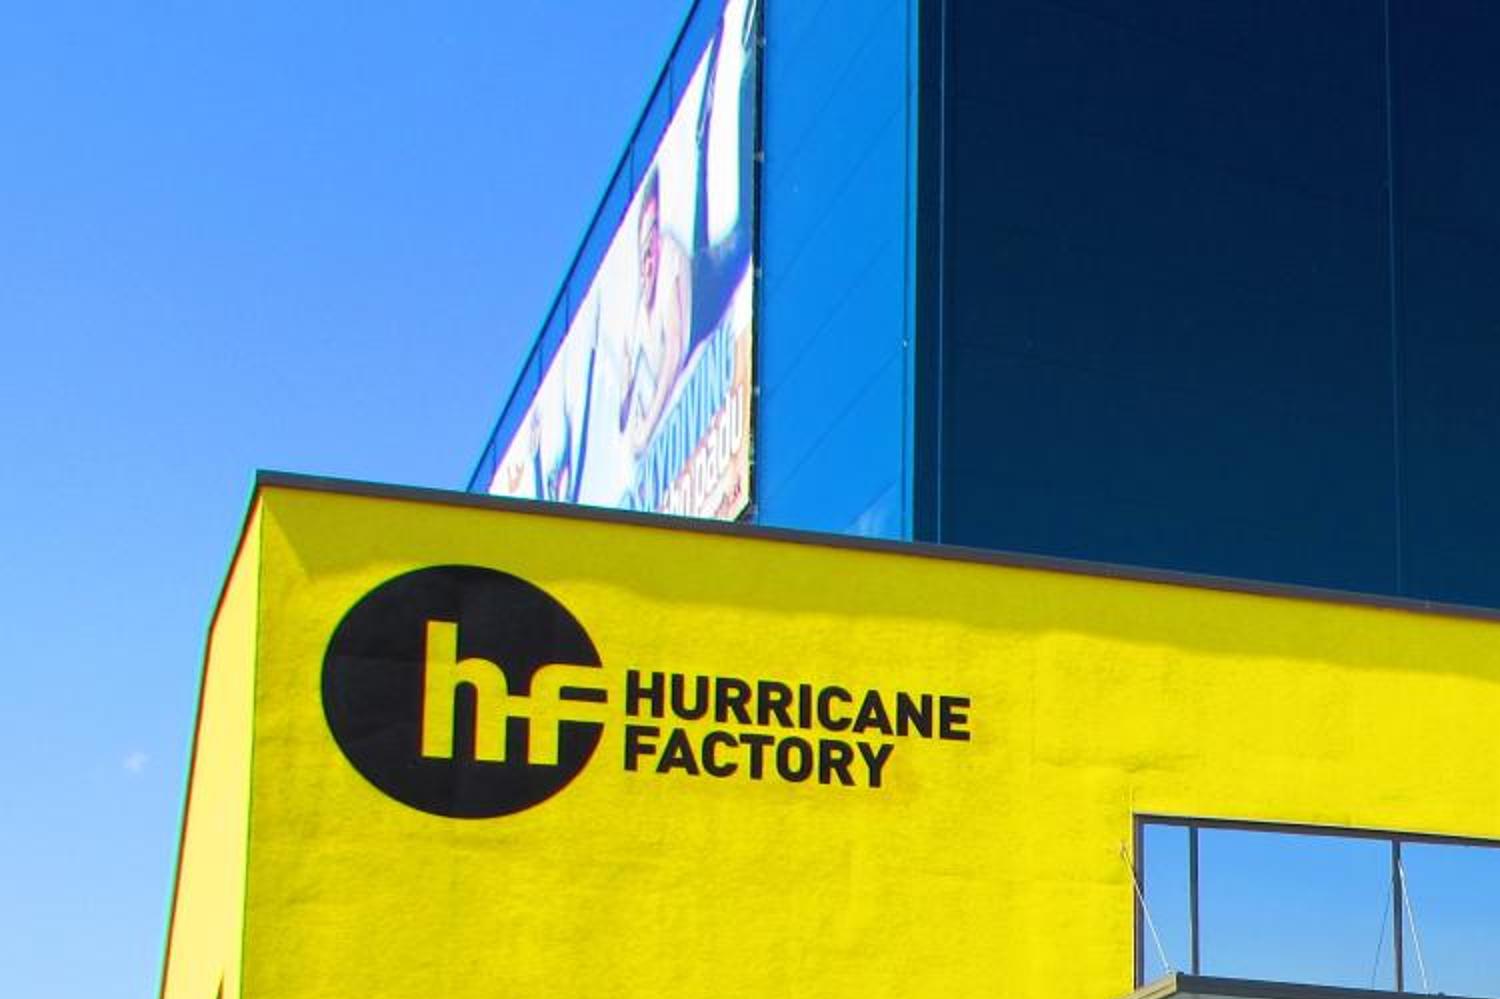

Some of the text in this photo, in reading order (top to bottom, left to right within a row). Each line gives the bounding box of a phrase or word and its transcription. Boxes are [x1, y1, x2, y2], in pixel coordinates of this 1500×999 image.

[421, 620, 607, 766] hf
[624, 669, 971, 741] HURRICANE
[623, 723, 895, 789] FACTORY
